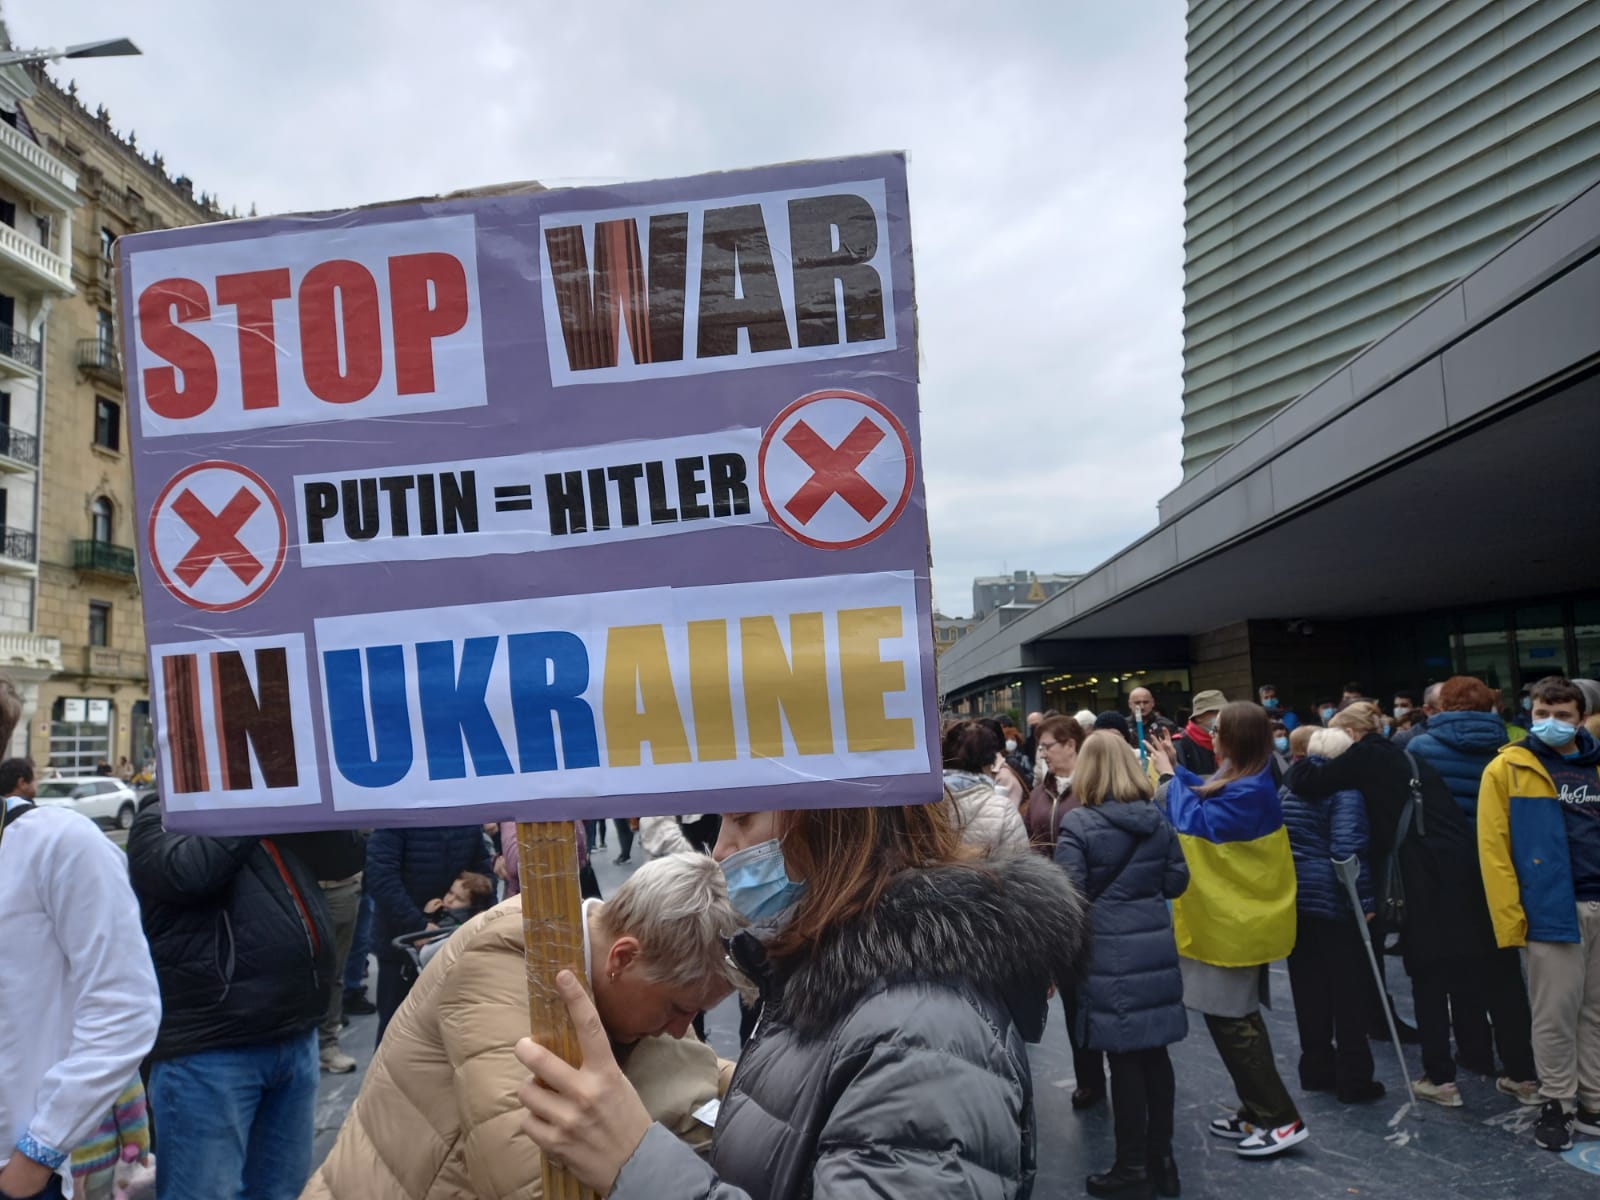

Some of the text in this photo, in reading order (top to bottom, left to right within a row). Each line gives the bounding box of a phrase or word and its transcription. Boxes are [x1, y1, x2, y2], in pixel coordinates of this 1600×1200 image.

[138, 194, 886, 419] STOP WAR
[304, 452, 751, 544] PUTIN = HITLER
[161, 605, 915, 794] IN UKRAINE
